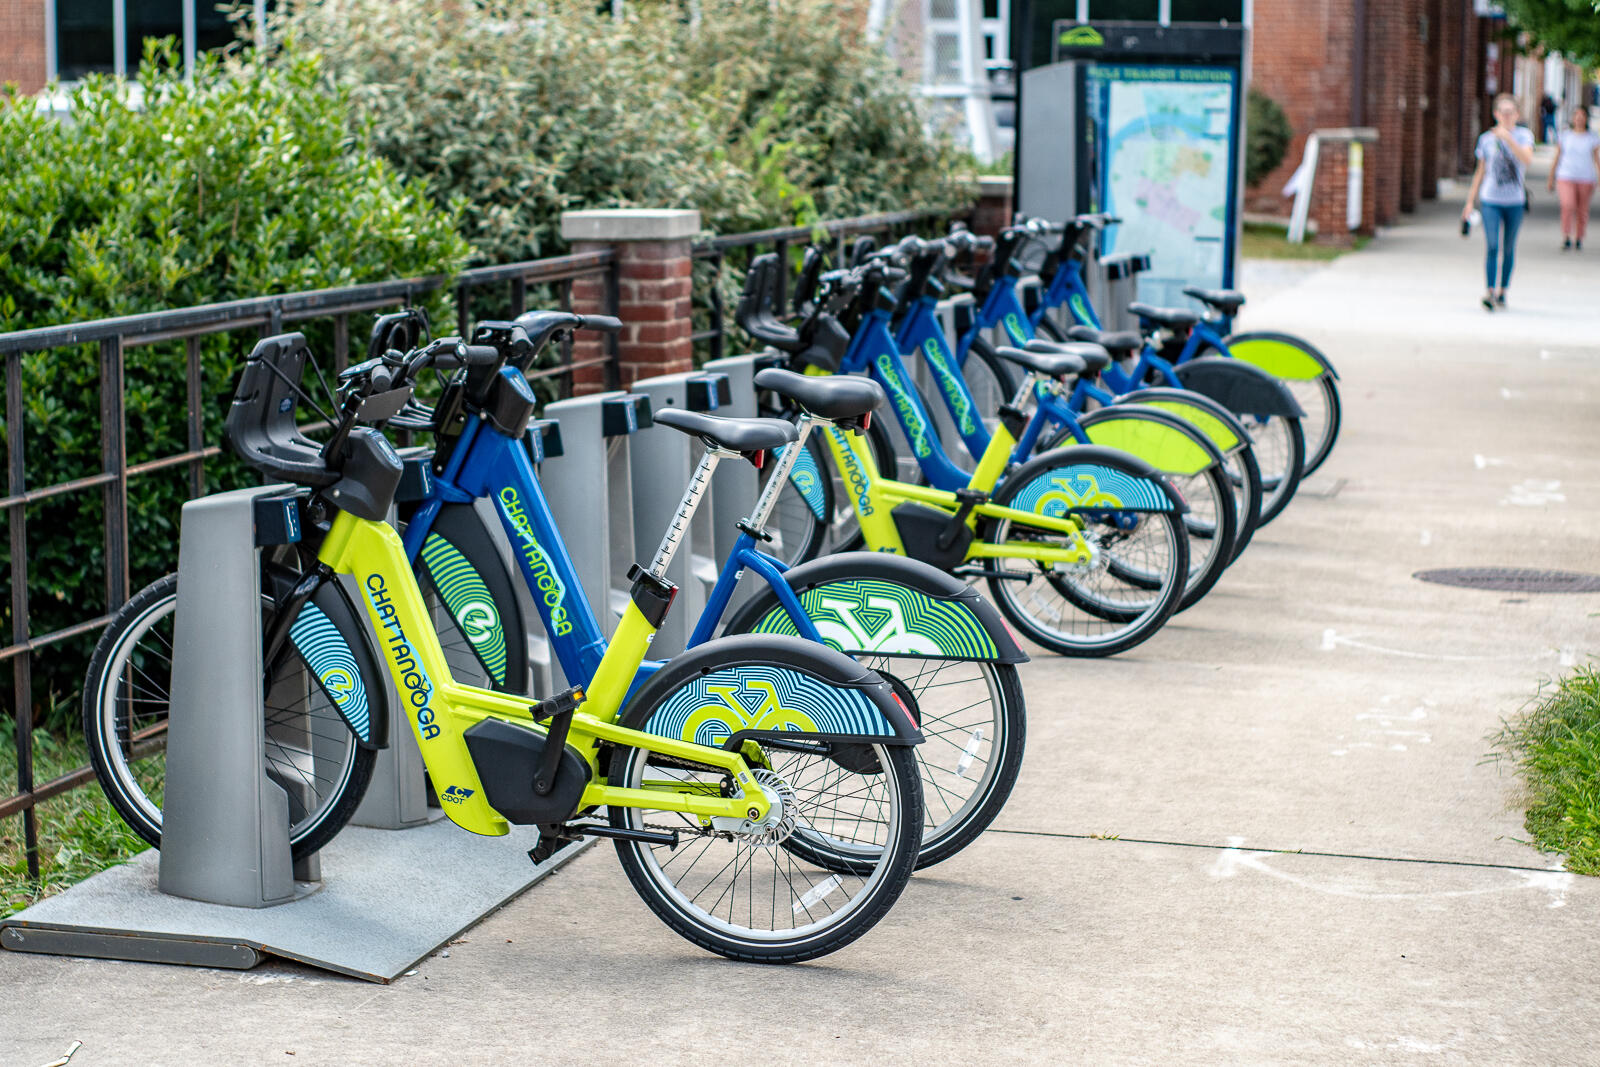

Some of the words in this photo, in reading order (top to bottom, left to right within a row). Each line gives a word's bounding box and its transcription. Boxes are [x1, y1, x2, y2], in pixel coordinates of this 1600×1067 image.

[500, 486, 573, 636] CHATTANOOGA
[366, 573, 441, 740] CHATTANOOGA
[441, 793, 466, 805] CDOT
